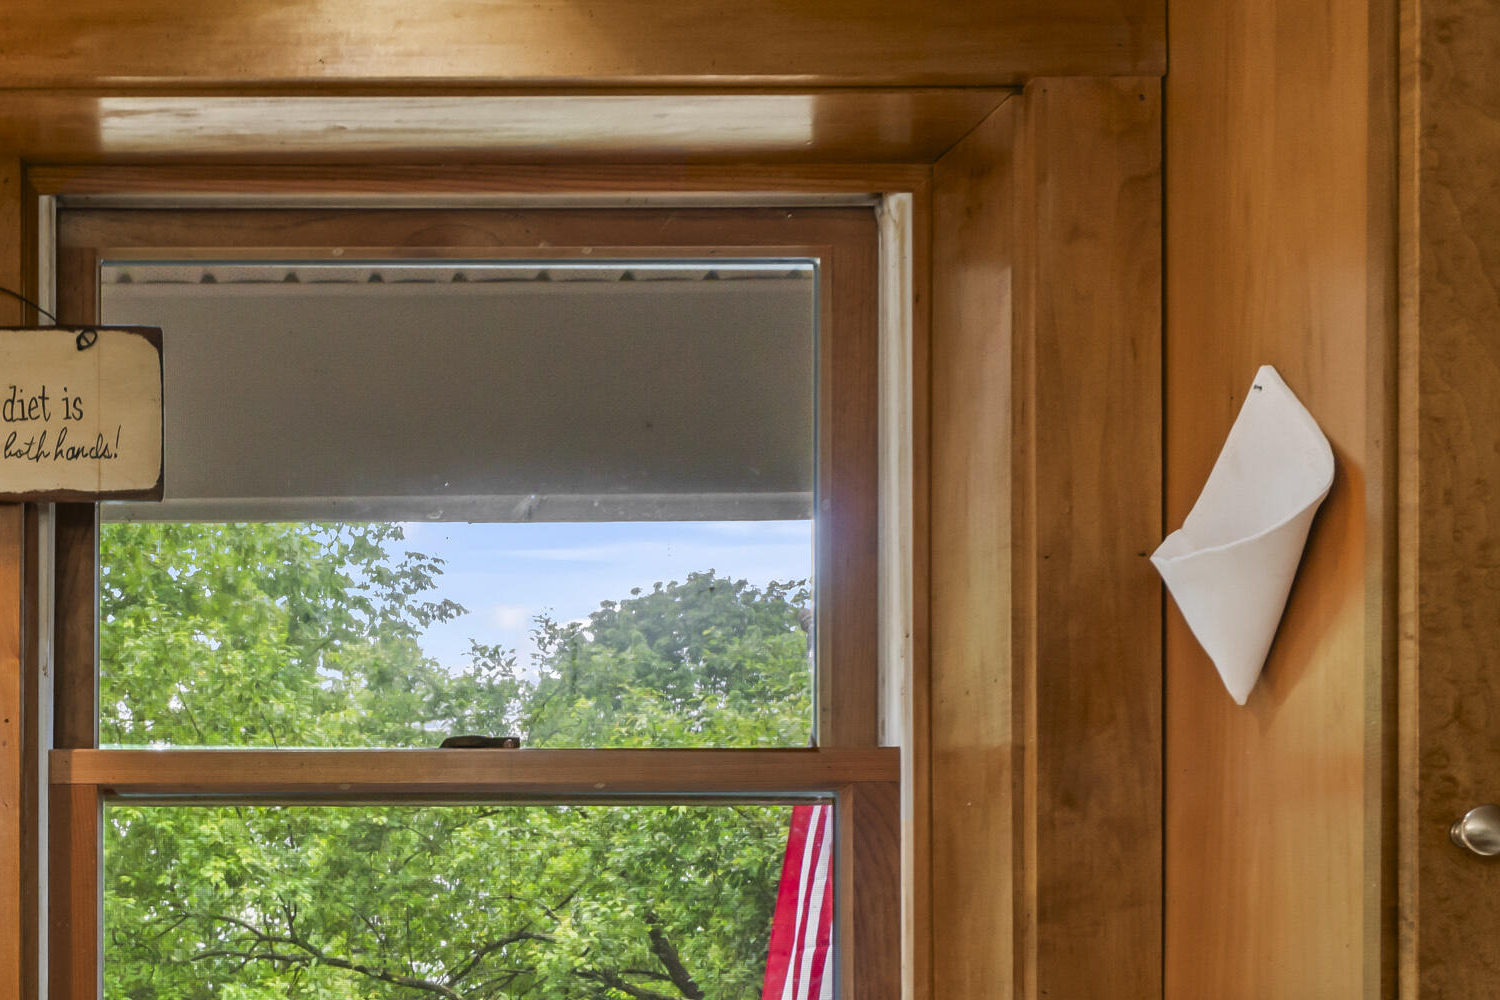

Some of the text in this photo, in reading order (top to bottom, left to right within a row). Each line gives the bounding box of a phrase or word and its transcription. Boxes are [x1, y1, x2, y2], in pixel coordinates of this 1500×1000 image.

[2, 385, 51, 423] diet
[61, 387, 84, 422] is
[3, 430, 51, 463] both
[53, 424, 122, 462] hands!
